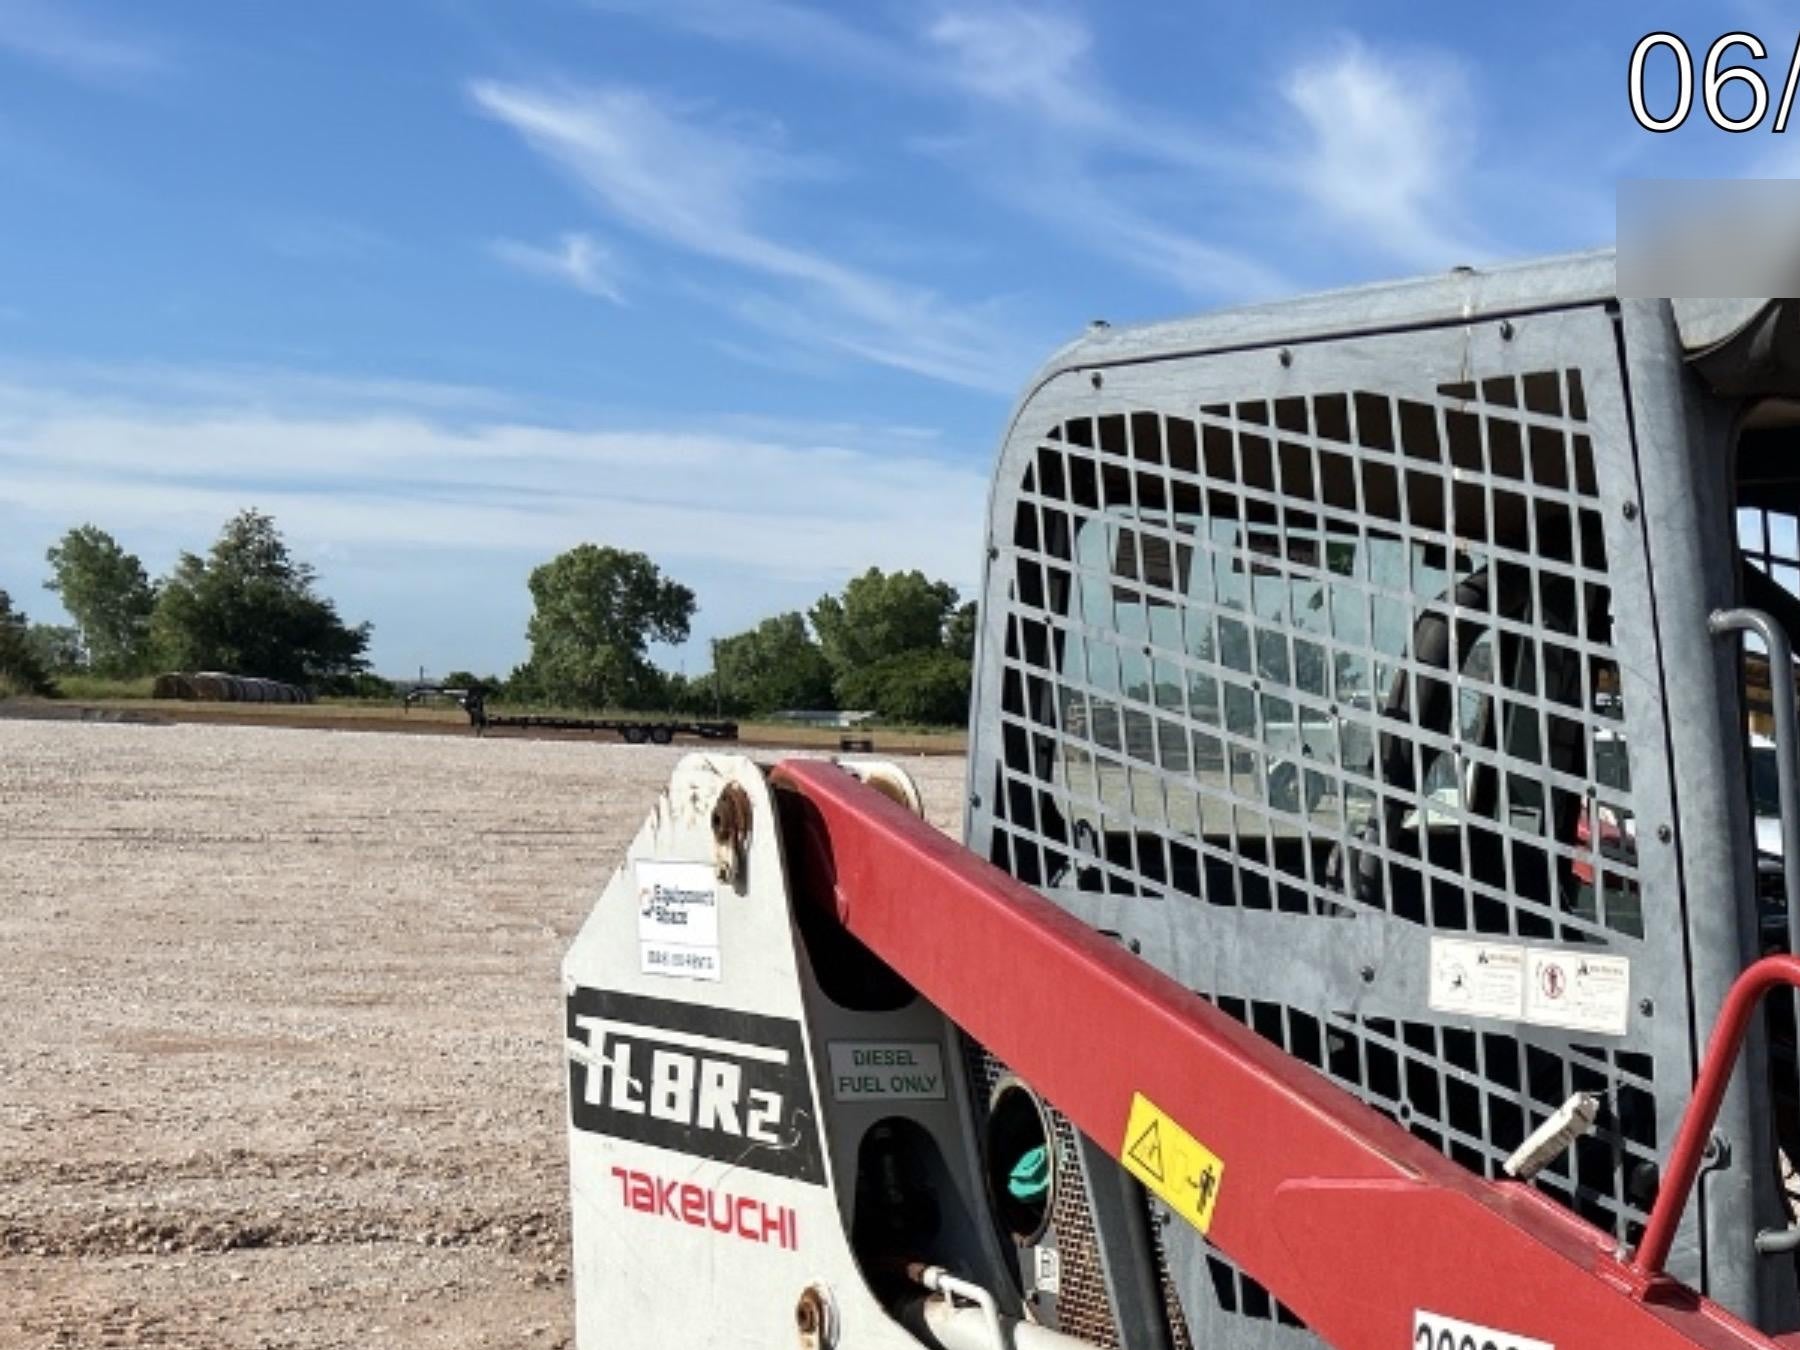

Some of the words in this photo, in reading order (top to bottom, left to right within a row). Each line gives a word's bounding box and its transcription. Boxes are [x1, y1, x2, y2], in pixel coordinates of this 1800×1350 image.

[852, 1049, 918, 1067] DIESEL
[838, 1075, 886, 1094] FUEL
[890, 1074, 938, 1094] ONLY
